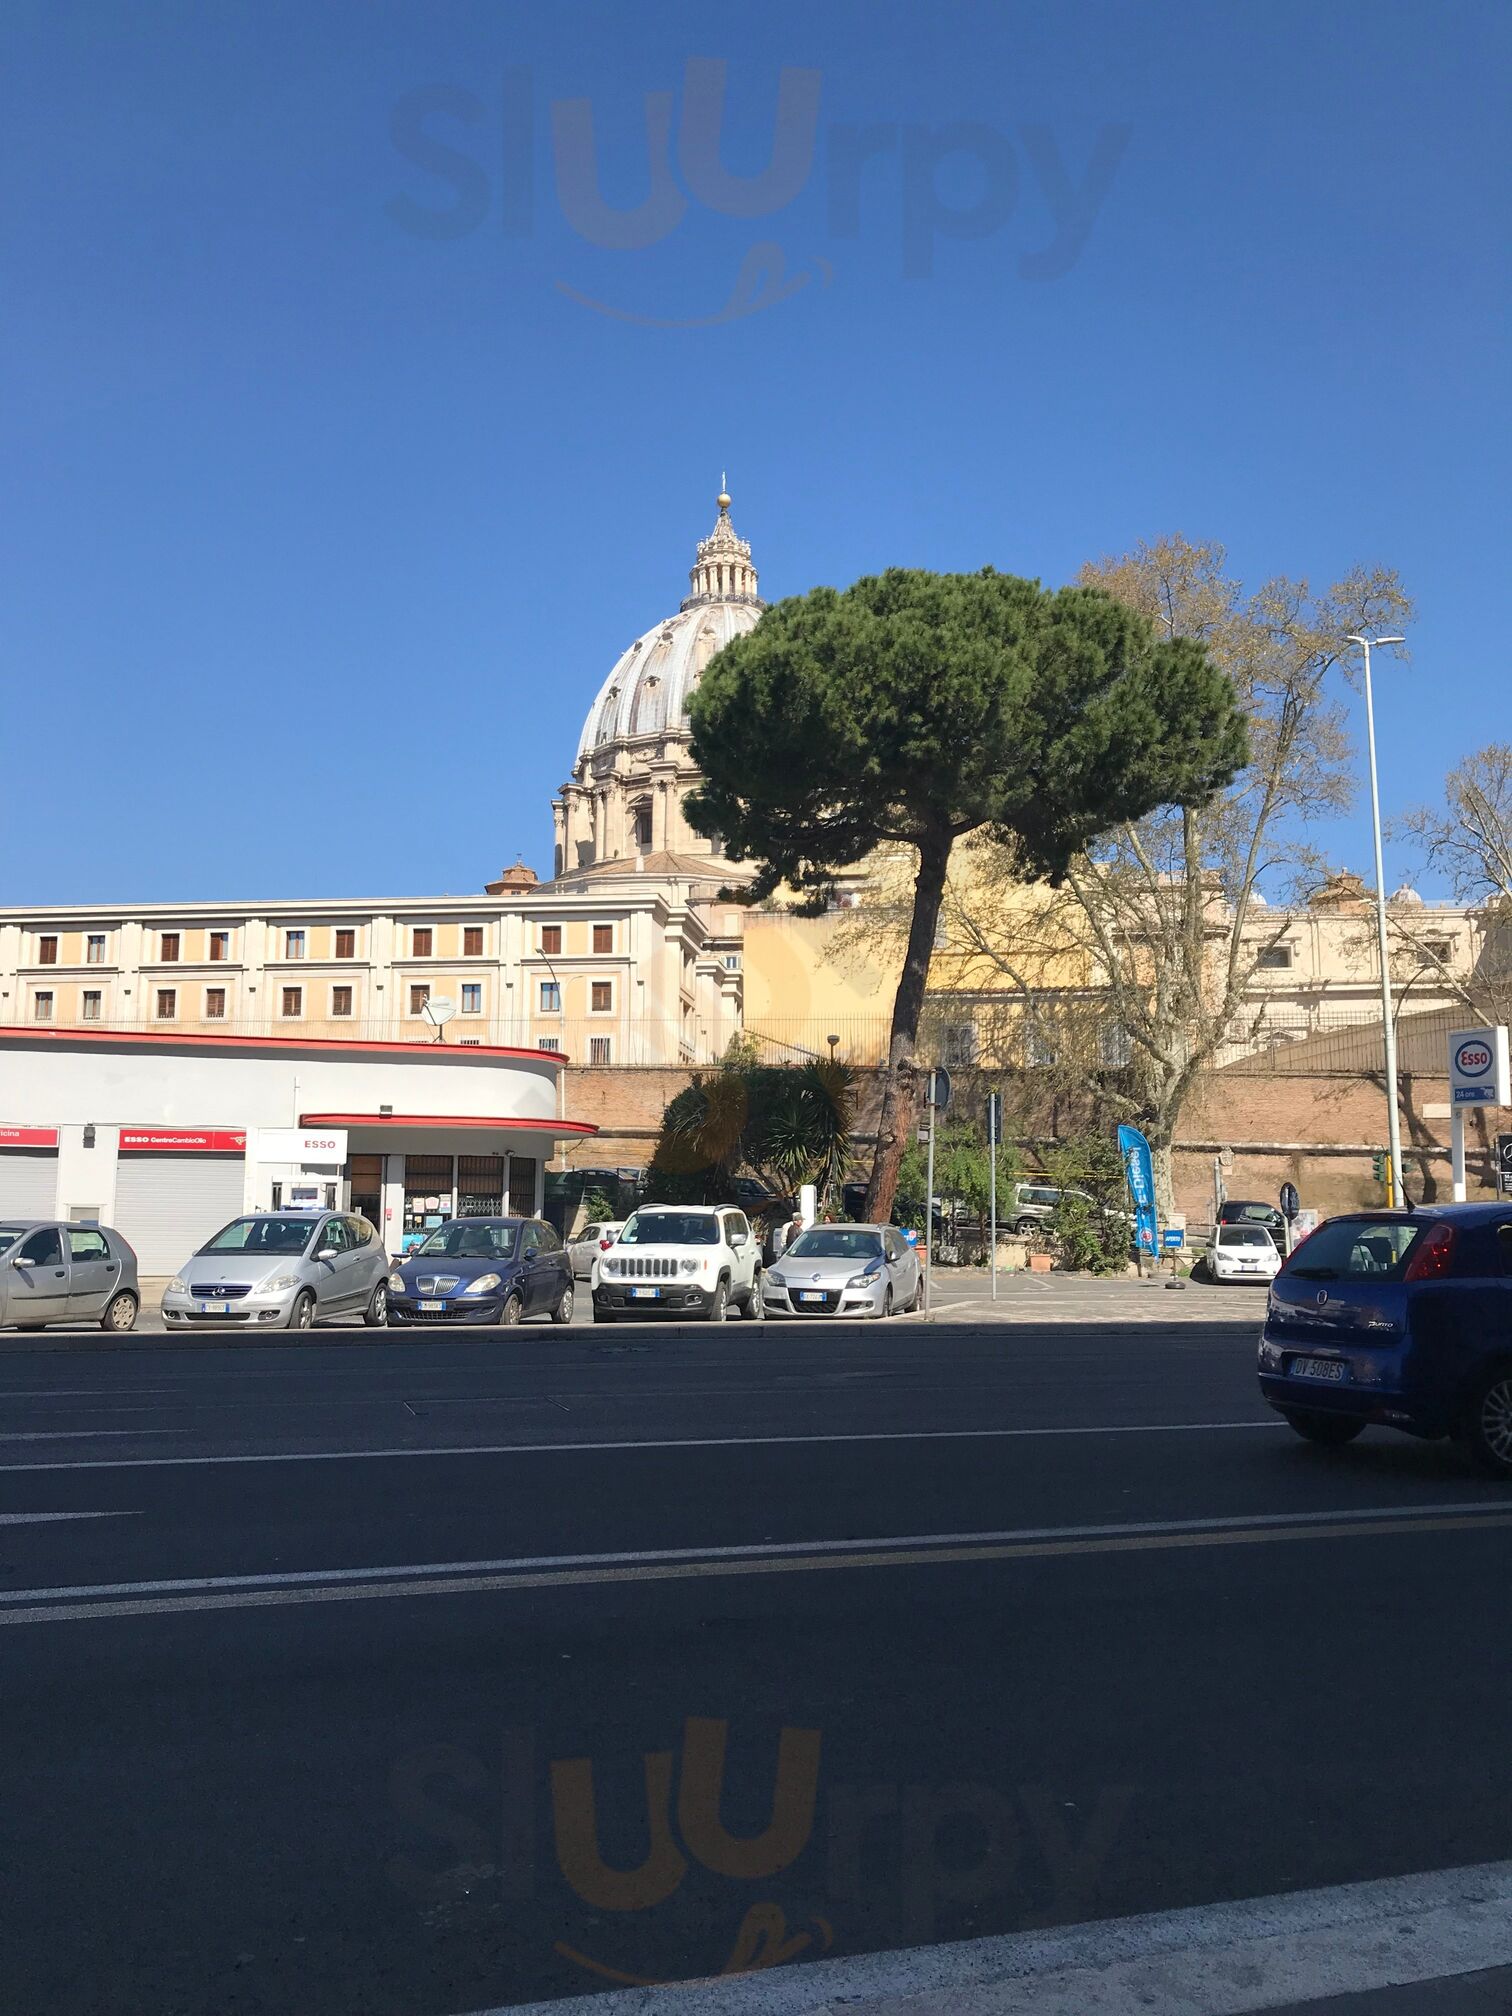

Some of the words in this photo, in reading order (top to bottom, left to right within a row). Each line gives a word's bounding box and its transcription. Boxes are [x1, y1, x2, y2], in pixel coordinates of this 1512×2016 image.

[1455, 1091, 1464, 1099] 24
[304, 1140, 336, 1149] ESSO
[1295, 1359, 1309, 1375] DV
[1310, 1360, 1343, 1379] 508ES
